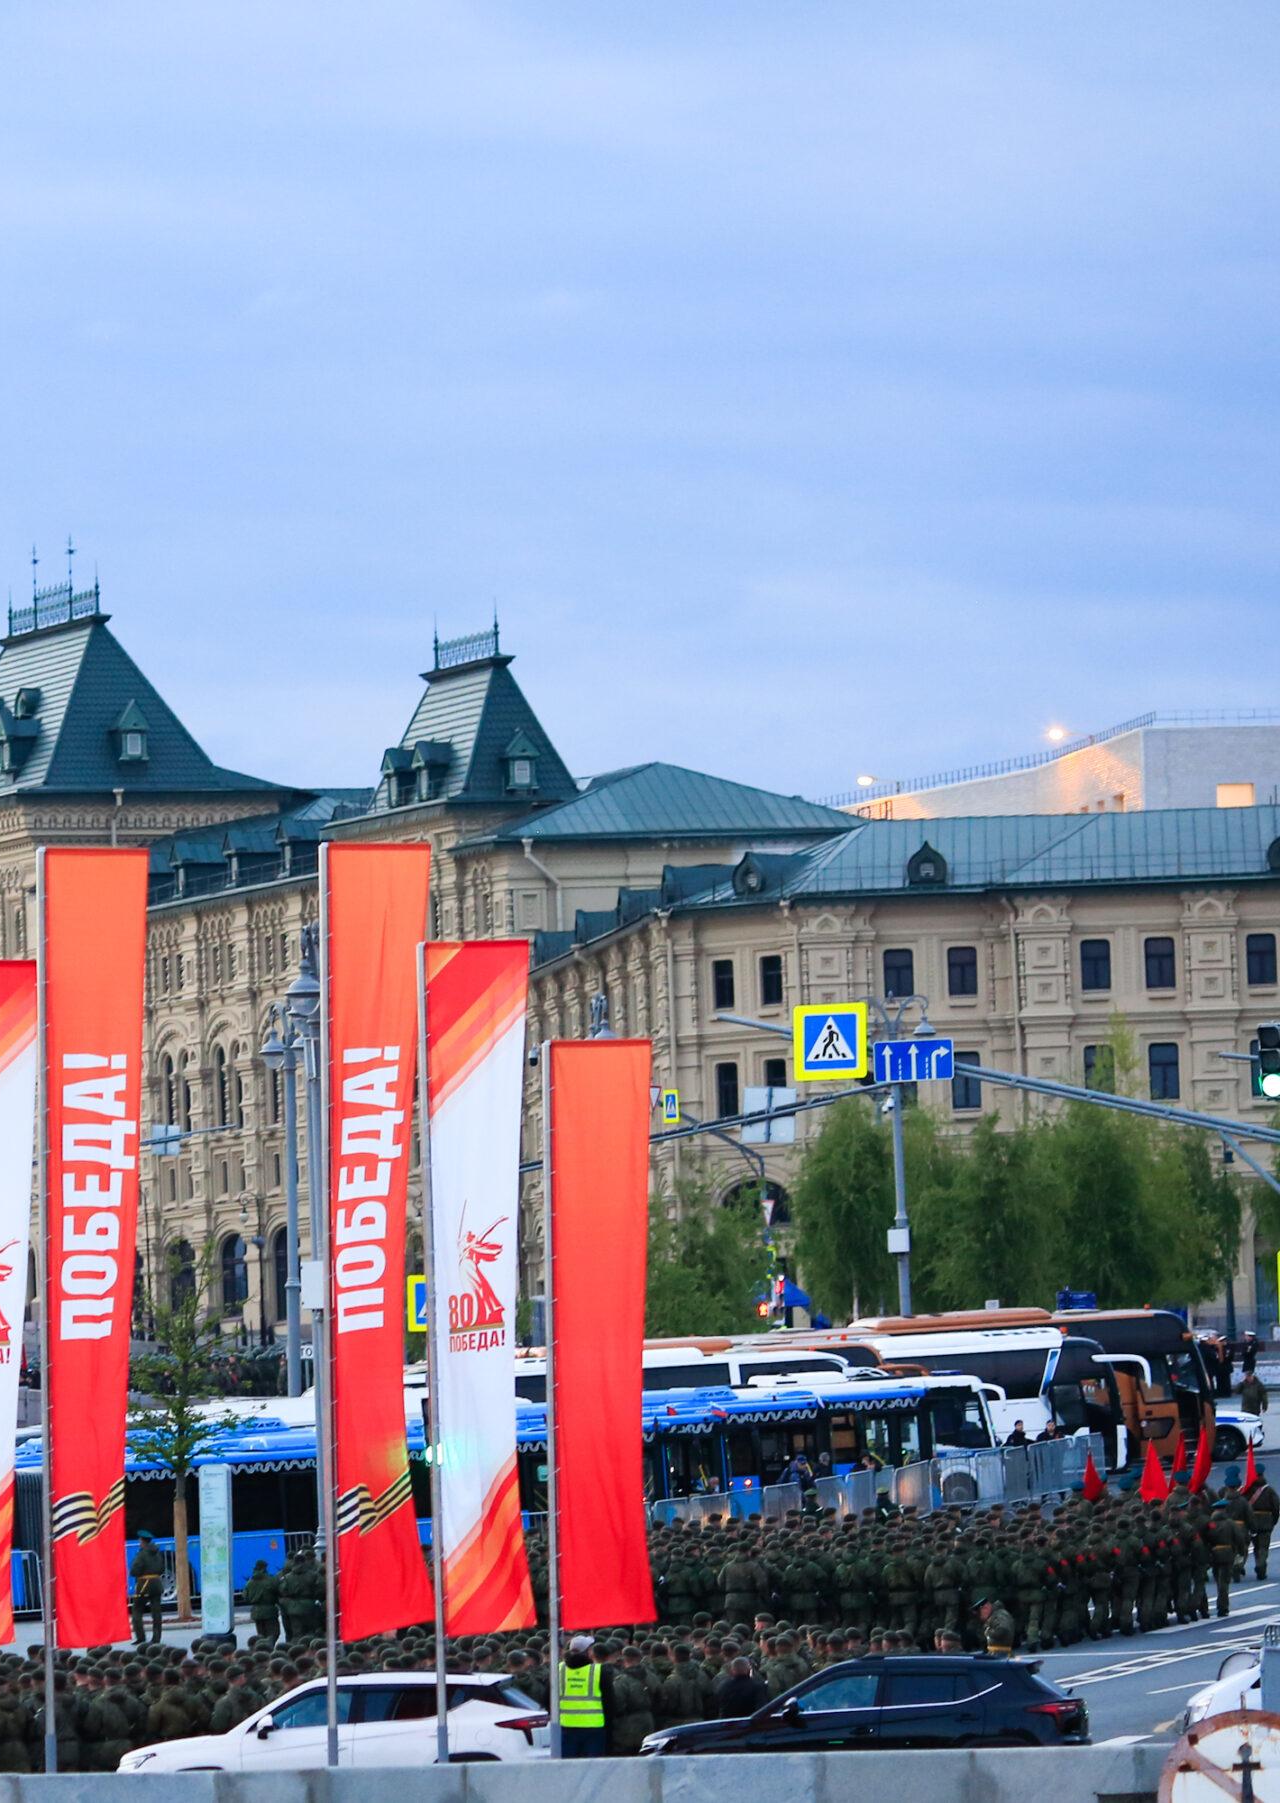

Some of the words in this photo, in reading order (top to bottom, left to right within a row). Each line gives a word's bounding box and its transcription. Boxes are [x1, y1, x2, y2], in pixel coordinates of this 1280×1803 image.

[60, 1053, 137, 1341] ПОБЕДА!
[336, 1046, 405, 1334] ПОБЕДА!
[448, 1293, 474, 1329] 80
[448, 1329, 506, 1353] ПОБЕДА!
